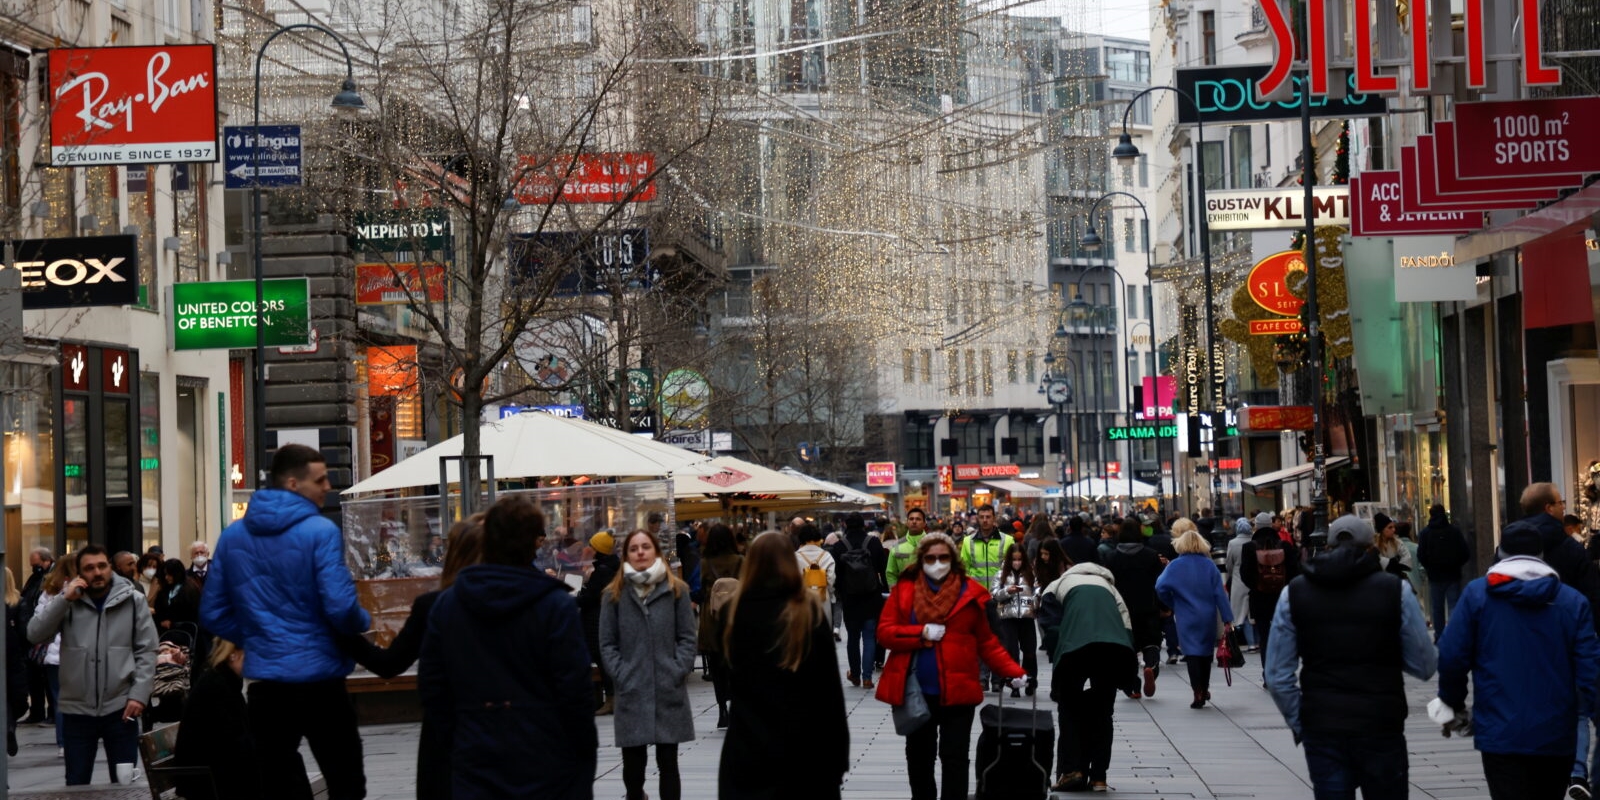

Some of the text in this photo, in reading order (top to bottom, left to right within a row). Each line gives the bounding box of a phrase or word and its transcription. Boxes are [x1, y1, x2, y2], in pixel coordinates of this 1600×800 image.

[1195, 77, 1368, 112] DOUGLS
[1493, 115, 1539, 138] 1000
[57, 148, 211, 162] GENUINE SINCE 1937
[1495, 139, 1570, 165] SPORTS
[1371, 183, 1400, 201] ACC
[1207, 197, 1262, 211] GUSTAV
[1208, 212, 1249, 223] EXHIBITION
[1380, 204, 1391, 222] &
[1400, 254, 1456, 268] PANDO
[0, 257, 127, 287] EOX
[178, 302, 228, 316] UNITED
[1277, 301, 1298, 309] SEIT
[178, 318, 197, 330] OF
[1255, 322, 1280, 331] CAFÉ
[1189, 385, 1198, 417] Marc
[1146, 406, 1174, 417] BPA
[1109, 425, 1178, 439] SALAMANDE
